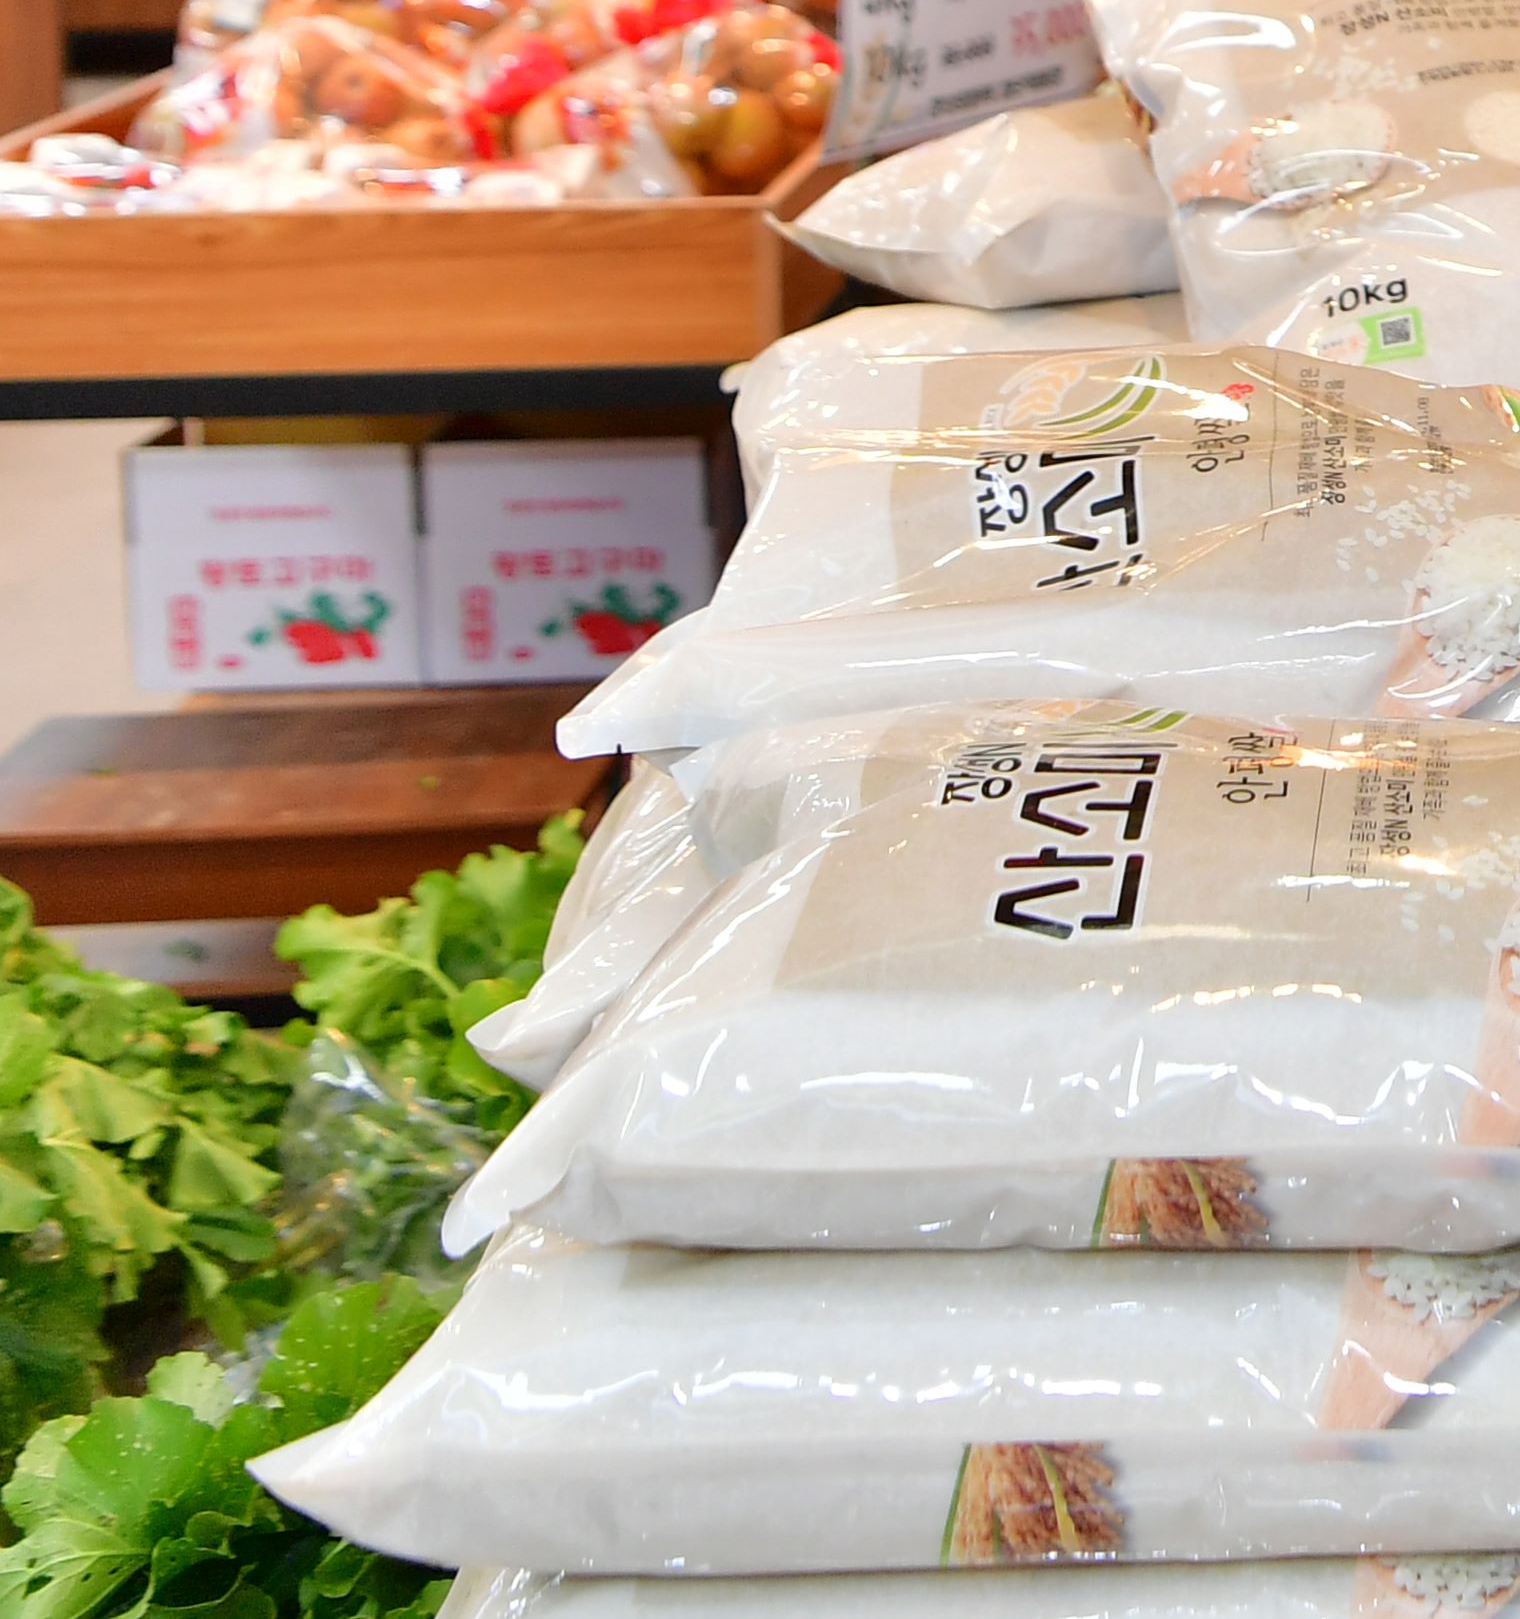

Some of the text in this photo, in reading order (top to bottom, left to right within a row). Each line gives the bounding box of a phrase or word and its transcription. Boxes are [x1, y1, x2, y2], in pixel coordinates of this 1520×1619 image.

[1322, 278, 1409, 318] 10kg
[1322, 435, 1348, 471] 산소미
[1320, 471, 1347, 506] 장성N
[941, 741, 1028, 806] 장성N
[1216, 731, 1298, 804] 안평쌀
[1383, 779, 1415, 817] 산소미
[993, 742, 1179, 940] 산소미
[1379, 818, 1412, 857] 장성N
